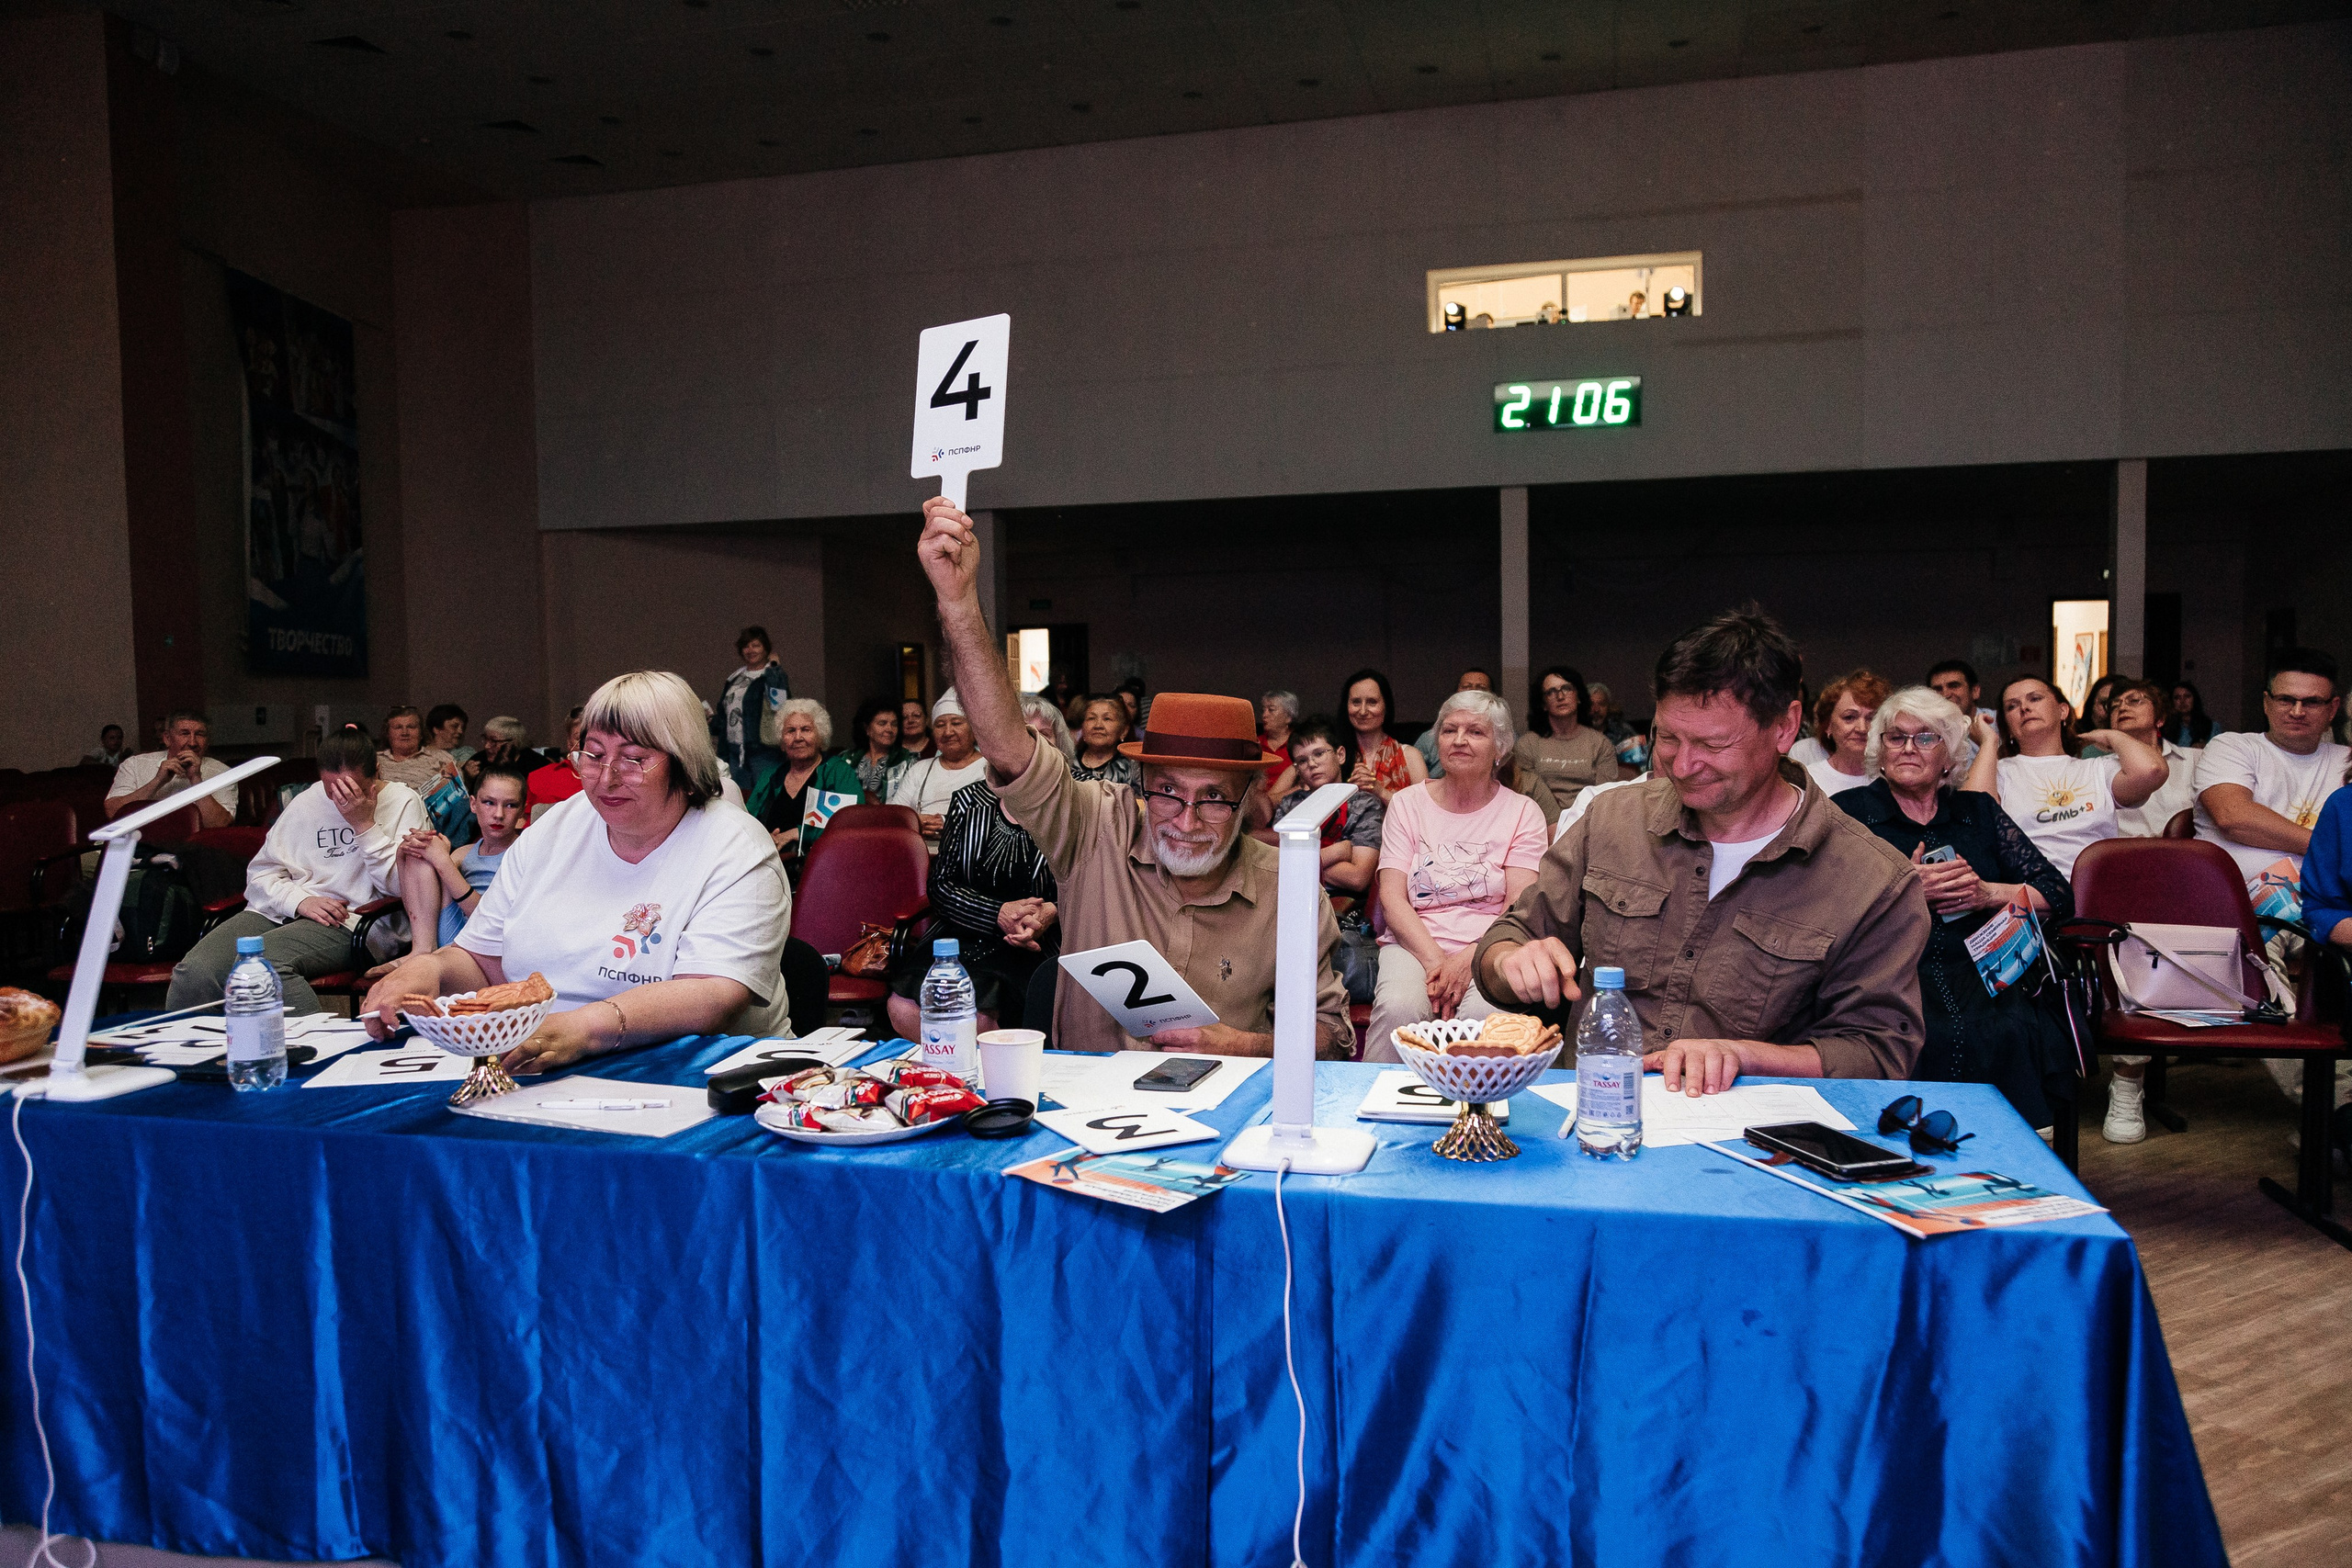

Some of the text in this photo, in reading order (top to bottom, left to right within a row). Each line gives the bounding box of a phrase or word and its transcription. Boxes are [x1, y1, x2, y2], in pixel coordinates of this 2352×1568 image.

[930, 340, 991, 421] 4
[948, 445, 981, 456] ПСПФНР
[267, 626, 354, 657] ТВОРЧЕСТВО
[1091, 961, 1177, 1010] 2
[1159, 1014, 1192, 1023] ПСПФНР
[922, 1043, 956, 1055] TASSAY
[379, 1055, 447, 1076] 5
[1592, 1079, 1621, 1089] TASSAY
[1085, 1114, 1179, 1140] 3
